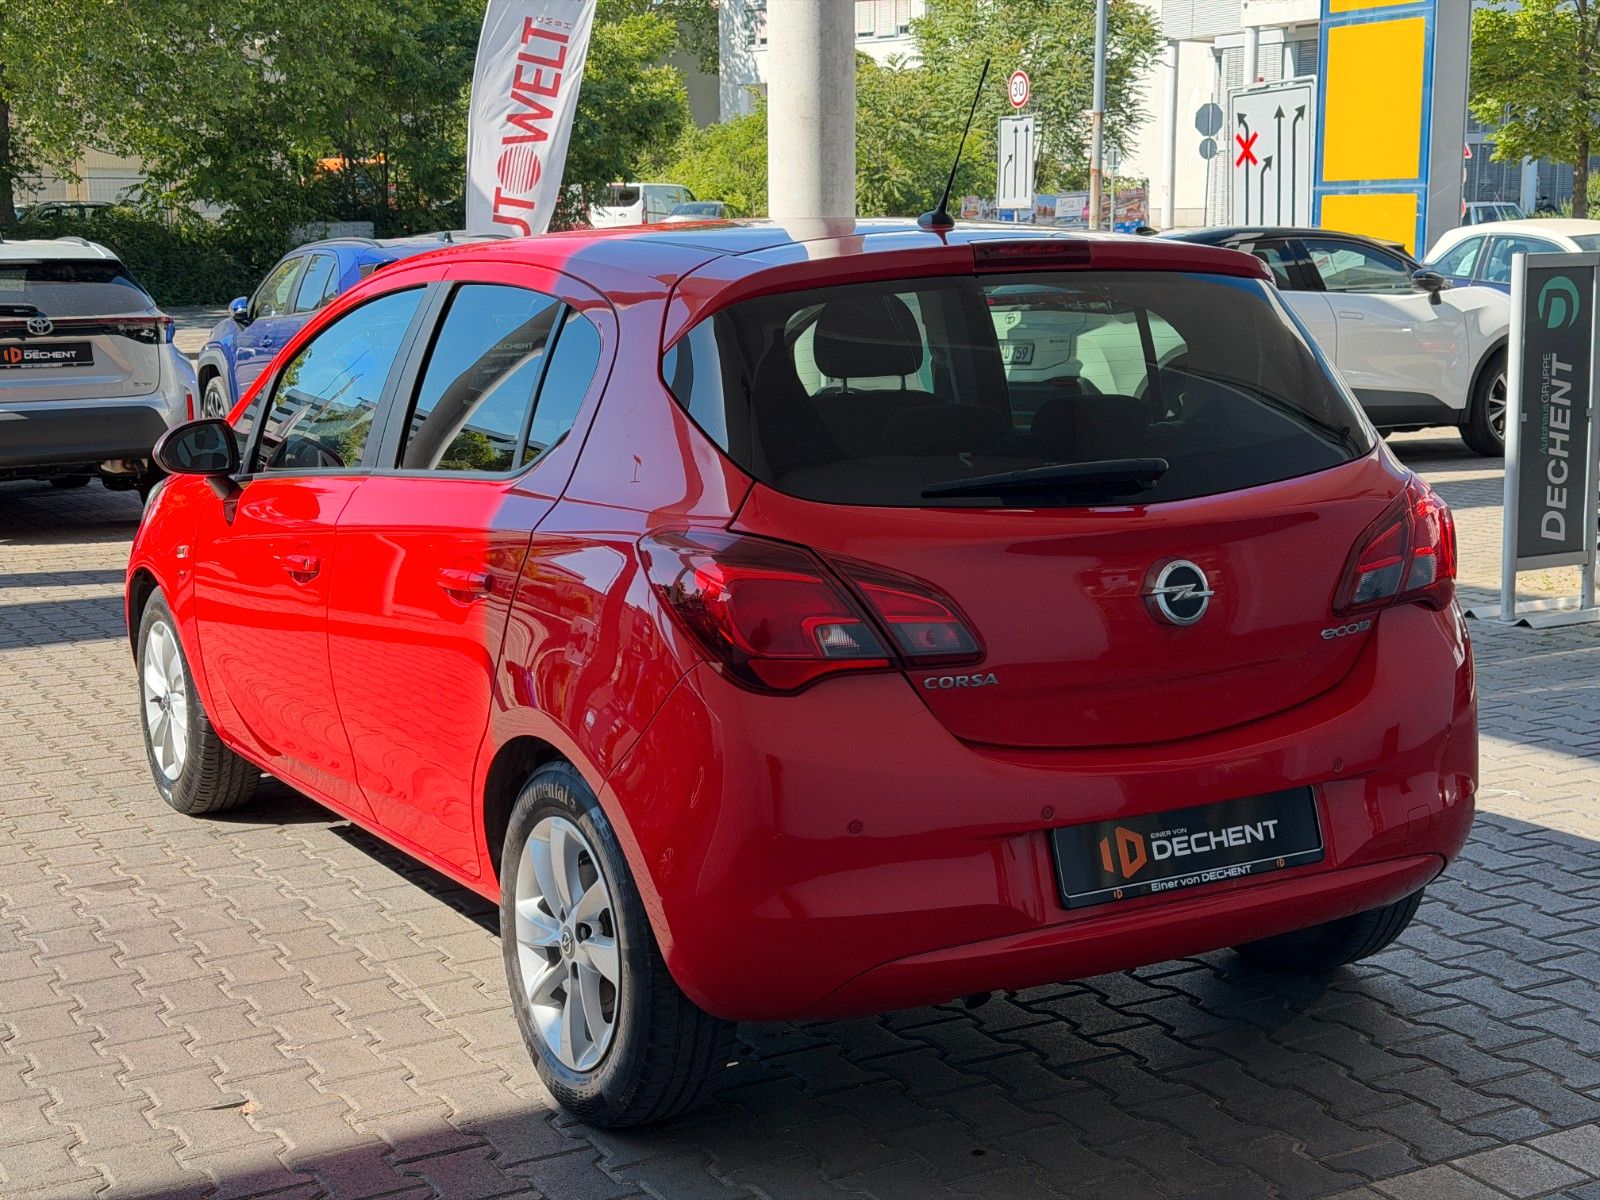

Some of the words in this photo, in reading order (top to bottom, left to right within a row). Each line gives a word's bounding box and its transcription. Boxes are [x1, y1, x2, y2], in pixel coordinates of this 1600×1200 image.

[1013, 81, 1025, 97] 30
[23, 351, 77, 360] DECHENT
[1541, 353, 1573, 541] DECHENT
[923, 673, 998, 689] CORSA
[1150, 830, 1172, 839] EINER
[1172, 826, 1188, 835] VON
[1151, 820, 1278, 861] DECHENT
[1151, 879, 1179, 892] Einer
[1180, 876, 1201, 886] von
[1201, 865, 1252, 882] DECHENT
